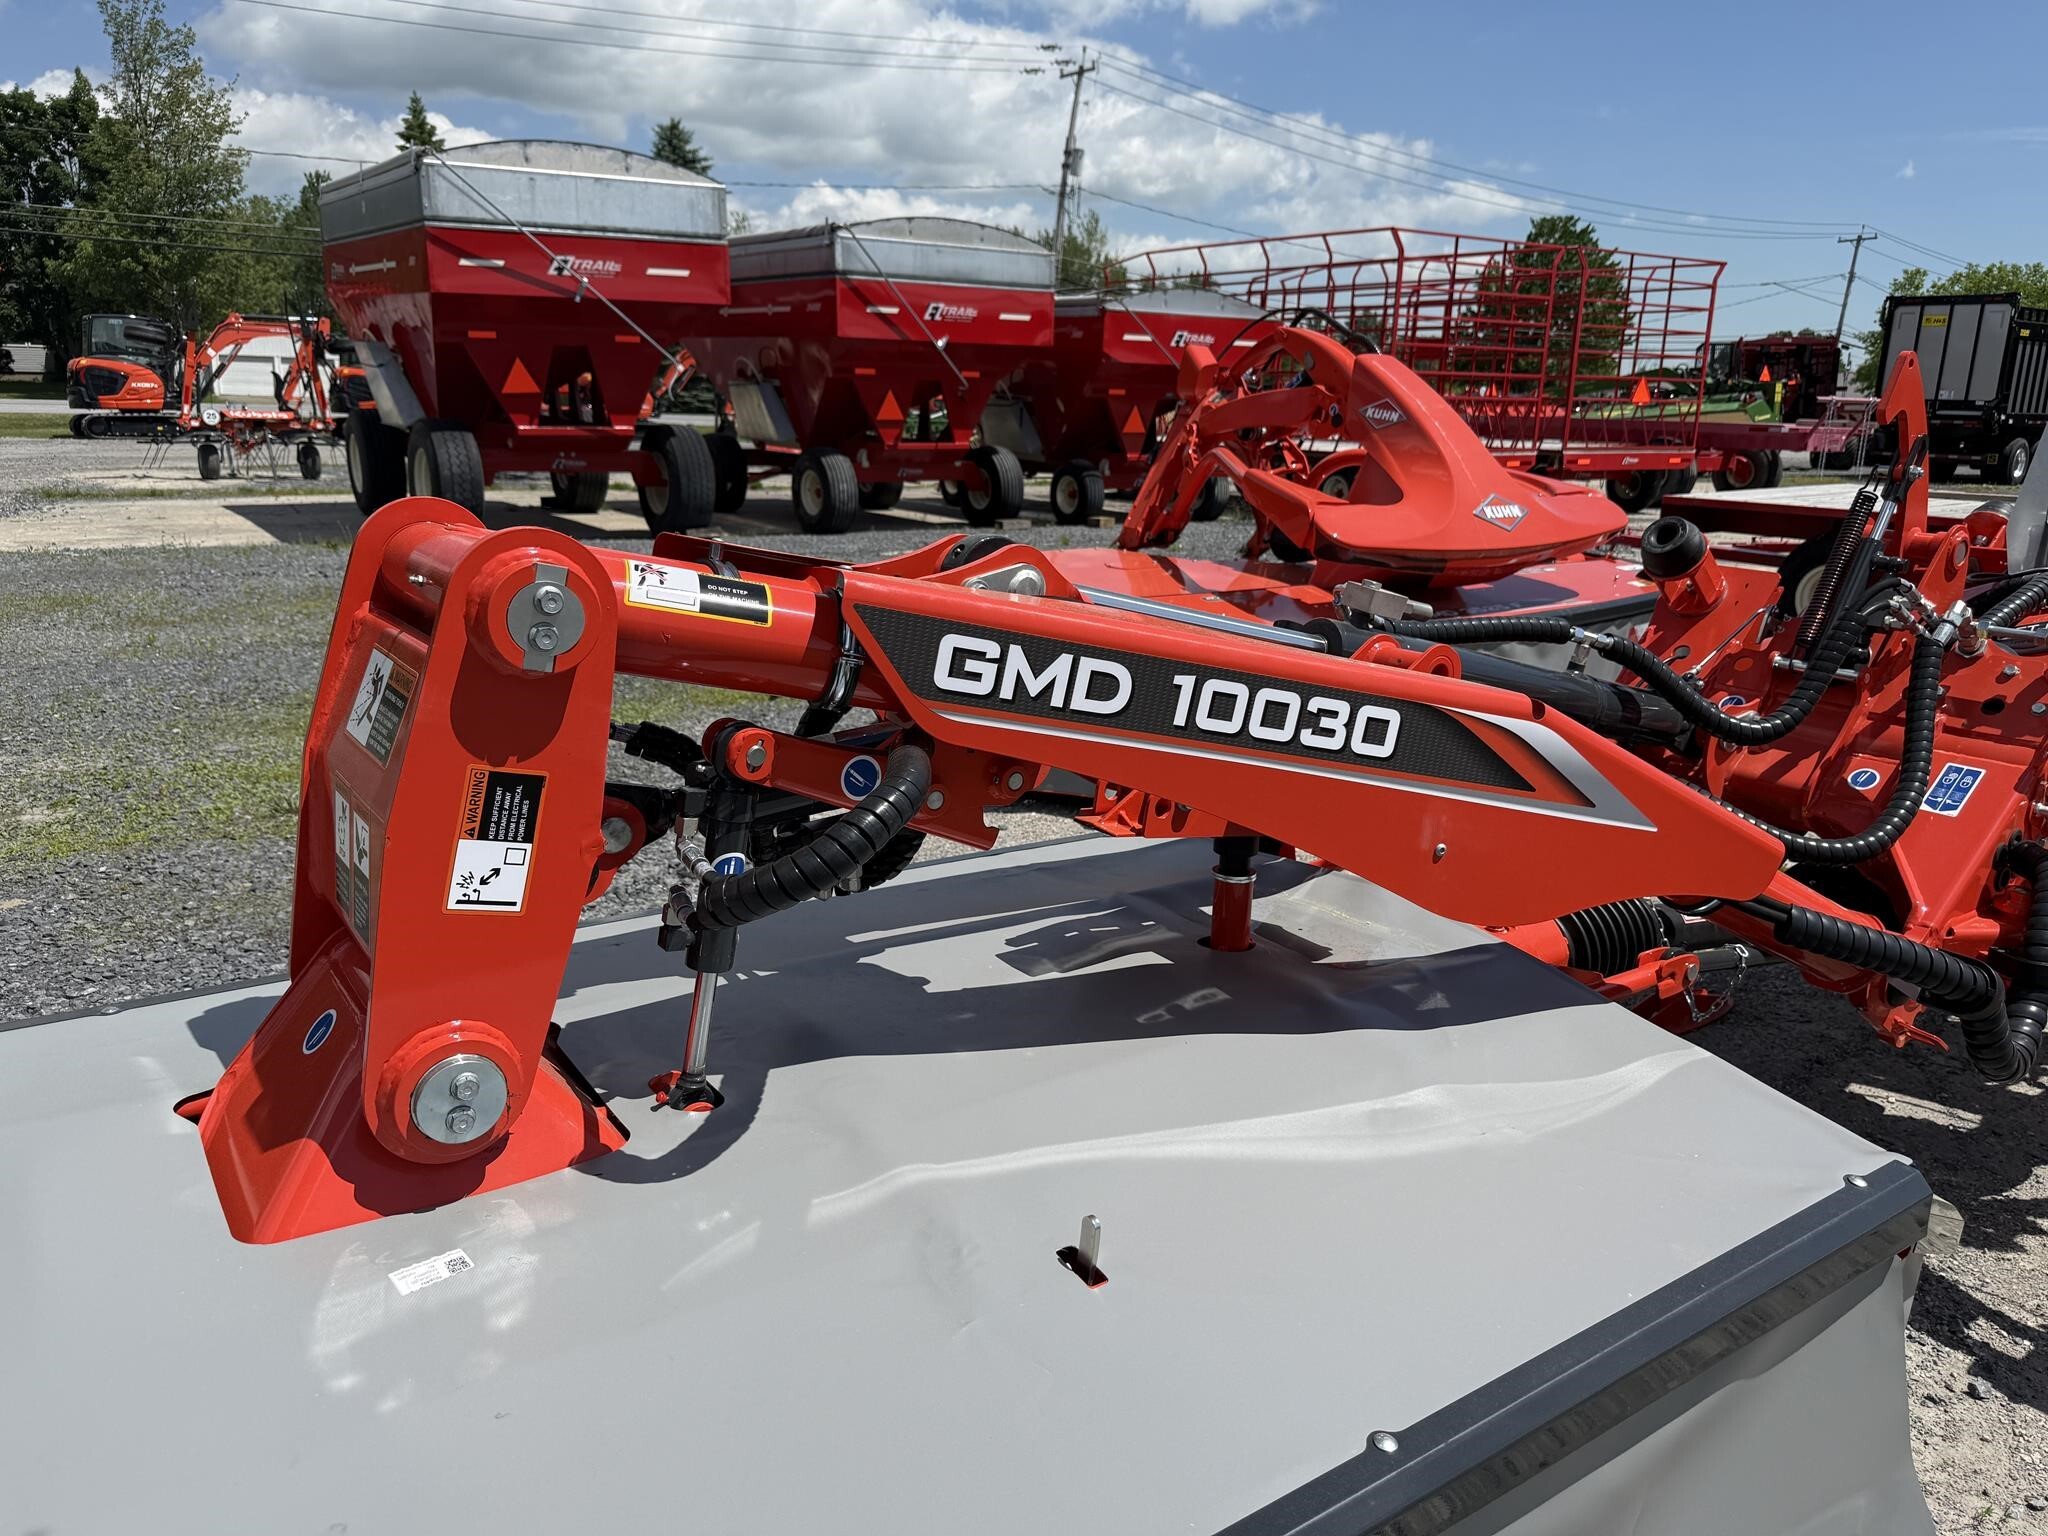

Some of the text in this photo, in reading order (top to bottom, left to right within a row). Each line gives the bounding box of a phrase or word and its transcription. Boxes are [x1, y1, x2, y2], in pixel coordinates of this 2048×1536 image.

[206, 412, 217, 421] 25
[229, 409, 290, 420] Kubota
[1366, 408, 1401, 423] KUHN
[1482, 504, 1522, 519] KUHN
[732, 588, 749, 596] STEP
[933, 633, 1401, 758] GMD 10030
[466, 771, 486, 824] WARNING
[488, 786, 503, 840] KEEP SUFFICIENT
[498, 791, 512, 840] DISTANCE AWAY
[508, 785, 523, 840] FROM ELECTRICAL
[517, 818, 526, 842] POWER
